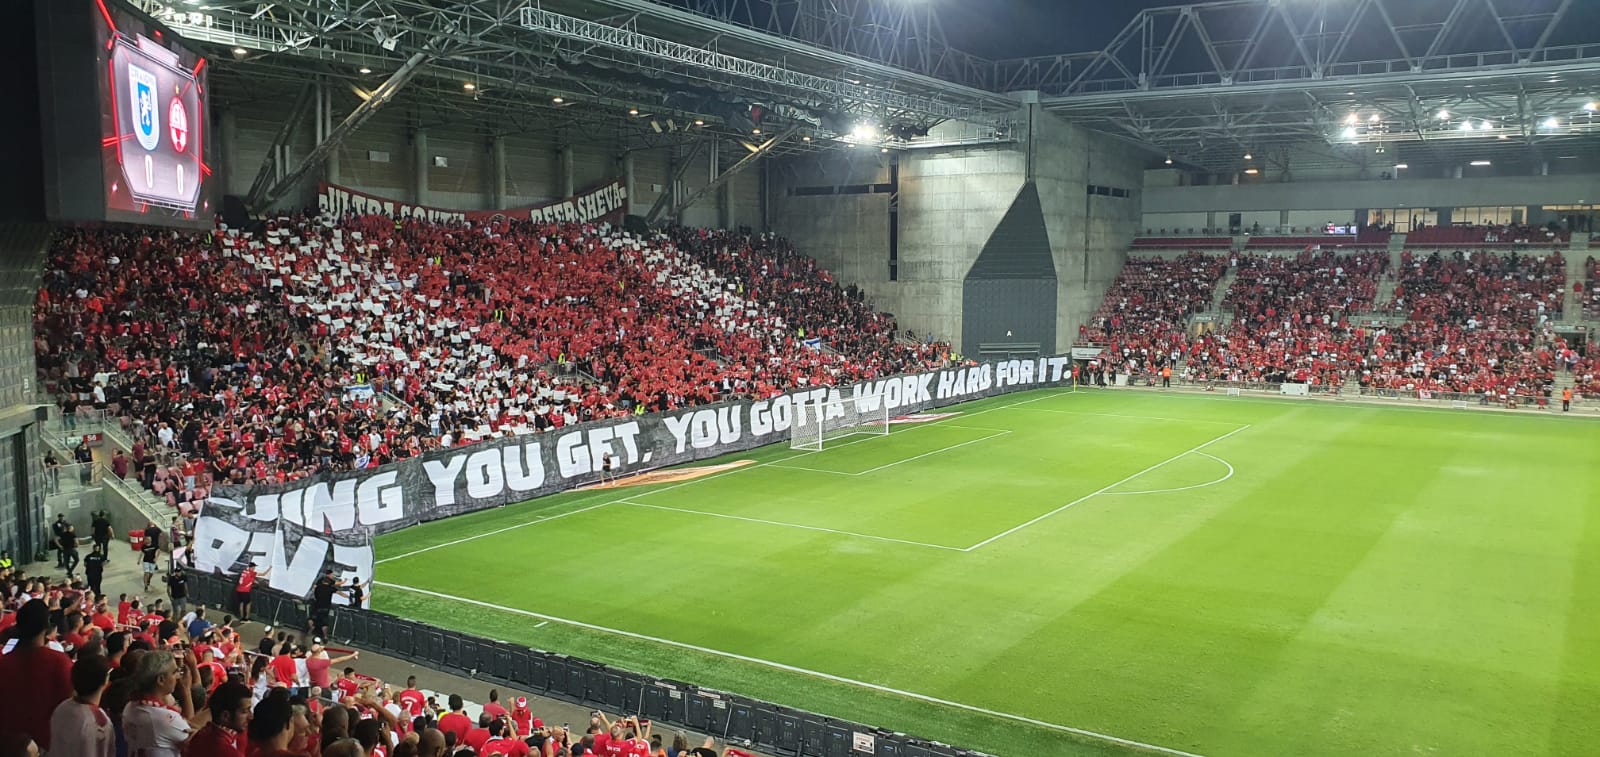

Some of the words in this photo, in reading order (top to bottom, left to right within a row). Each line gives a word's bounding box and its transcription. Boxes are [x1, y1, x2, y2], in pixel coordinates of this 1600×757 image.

[577, 182, 623, 224] SHEVA
[423, 442, 544, 507] YOU
[663, 405, 741, 454] YOU
[750, 388, 845, 436] GOTTA
[853, 372, 935, 413] WORK
[937, 363, 992, 399] HARD
[996, 360, 1034, 387] FOR
[1038, 357, 1071, 383] IT.
